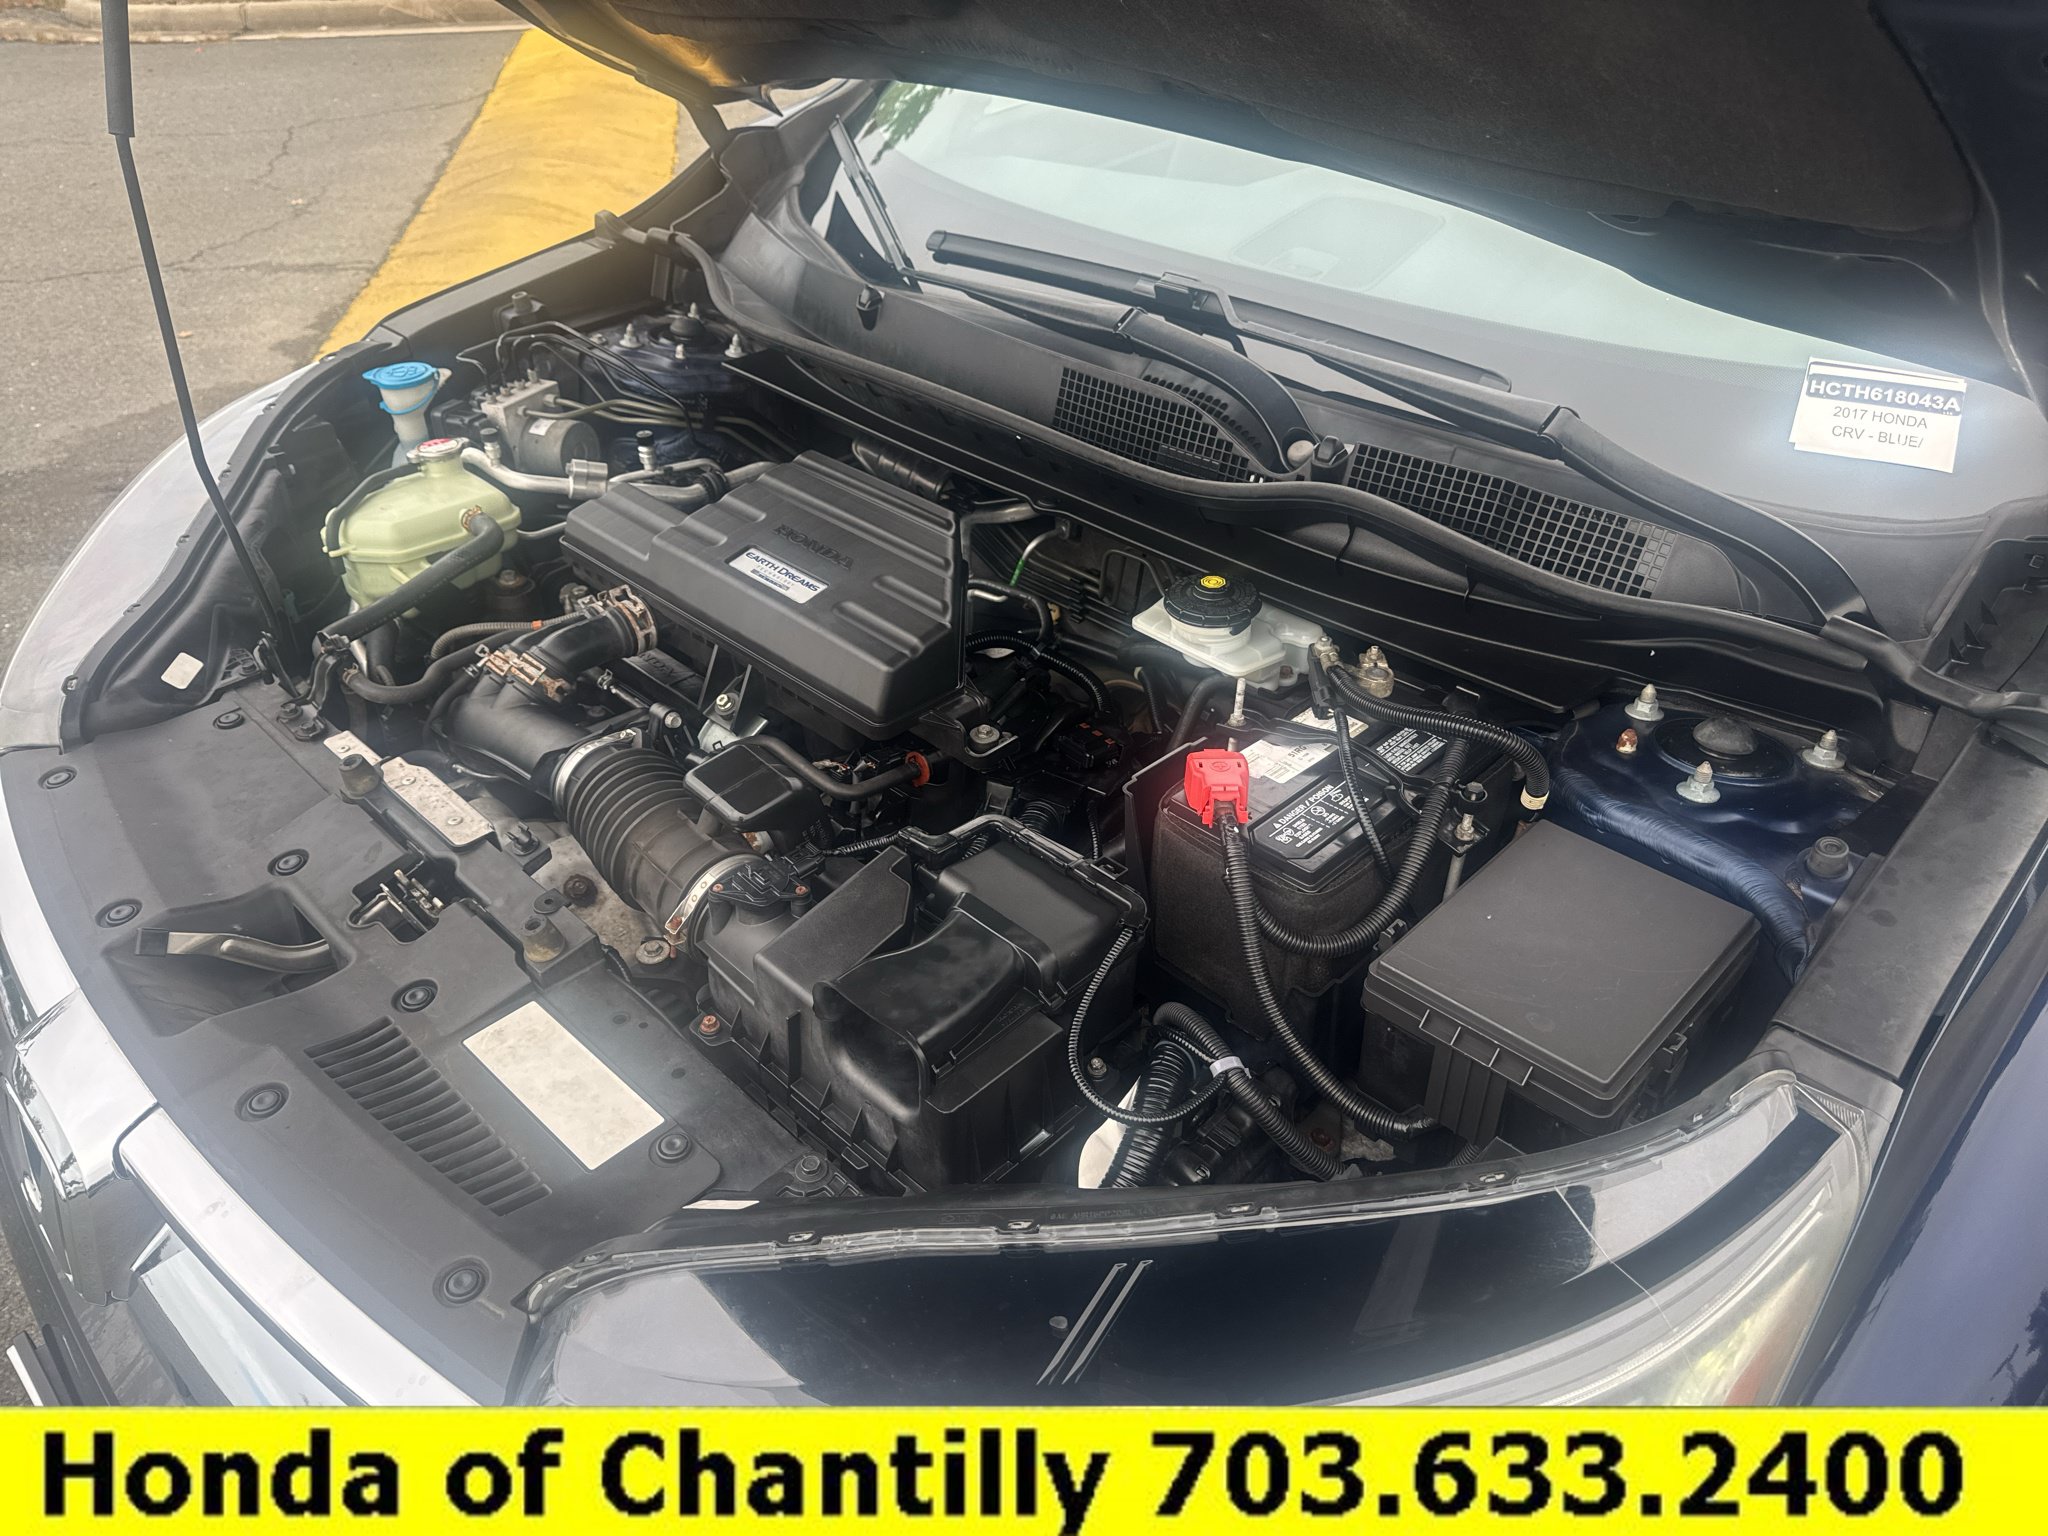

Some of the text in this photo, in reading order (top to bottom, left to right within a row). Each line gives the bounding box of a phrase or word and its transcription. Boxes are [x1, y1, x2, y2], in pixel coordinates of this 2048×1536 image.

[1809, 379, 1961, 412] HCTH618043A
[1833, 406, 1928, 429] 2017 HONDA
[1831, 425, 1865, 440] CRV
[1877, 431, 1924, 448] BLUE/
[772, 524, 854, 569] HONDA
[746, 552, 779, 571] EARTH
[777, 566, 820, 592] DREAMS
[1278, 804, 1307, 824] DANGER
[1308, 784, 1335, 803] POISON
